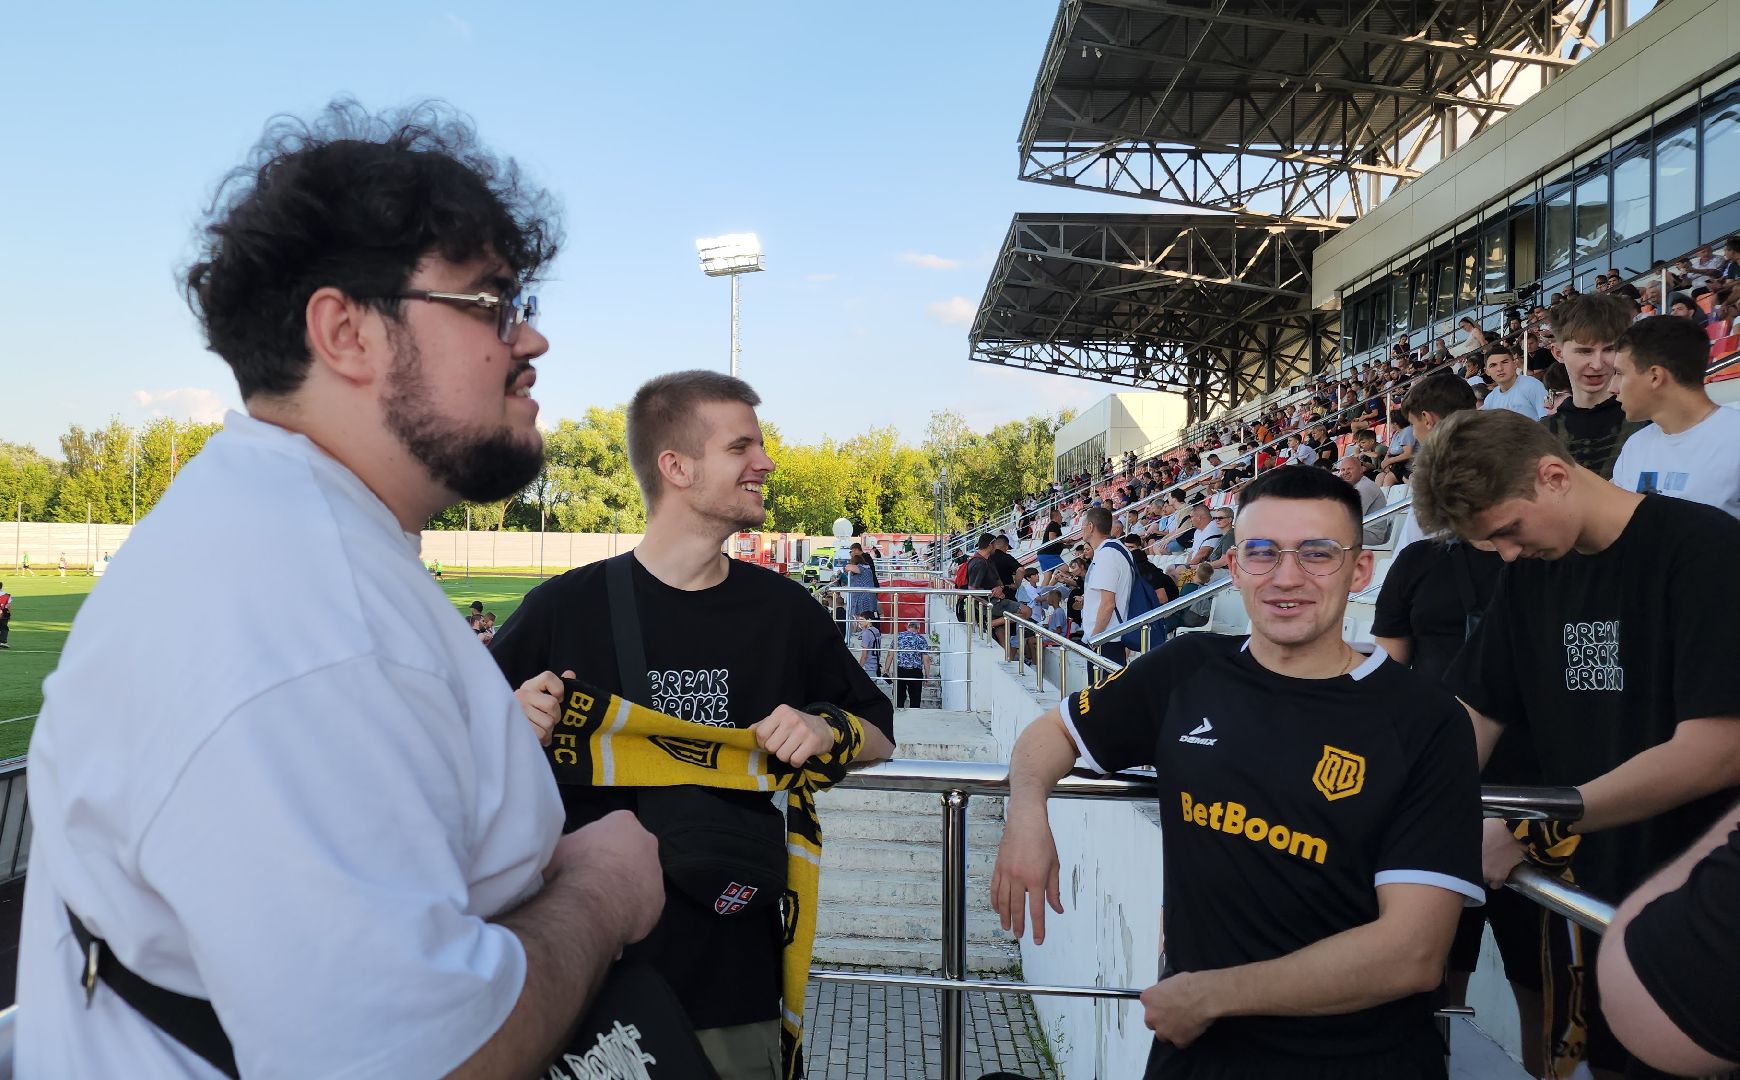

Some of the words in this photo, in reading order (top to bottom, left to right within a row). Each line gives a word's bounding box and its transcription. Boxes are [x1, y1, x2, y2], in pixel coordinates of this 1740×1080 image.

[1567, 645, 1619, 668] BROK
[647, 669, 729, 697] BREAK
[1181, 791, 1328, 865] BetBoom
